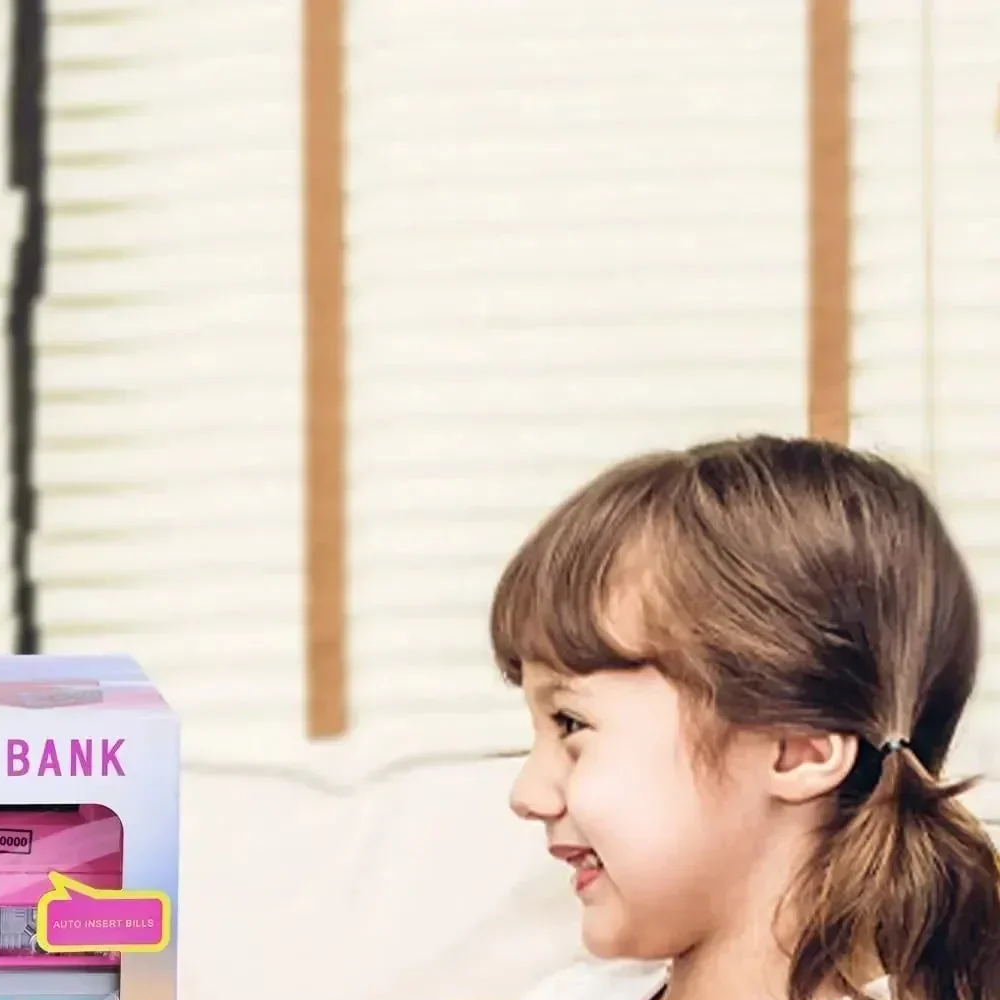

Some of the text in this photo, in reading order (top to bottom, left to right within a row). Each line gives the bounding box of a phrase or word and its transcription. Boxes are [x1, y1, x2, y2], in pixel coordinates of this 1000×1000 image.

[6, 738, 126, 777] BANK
[52, 918, 154, 929] AUTO INSERT BILLS
